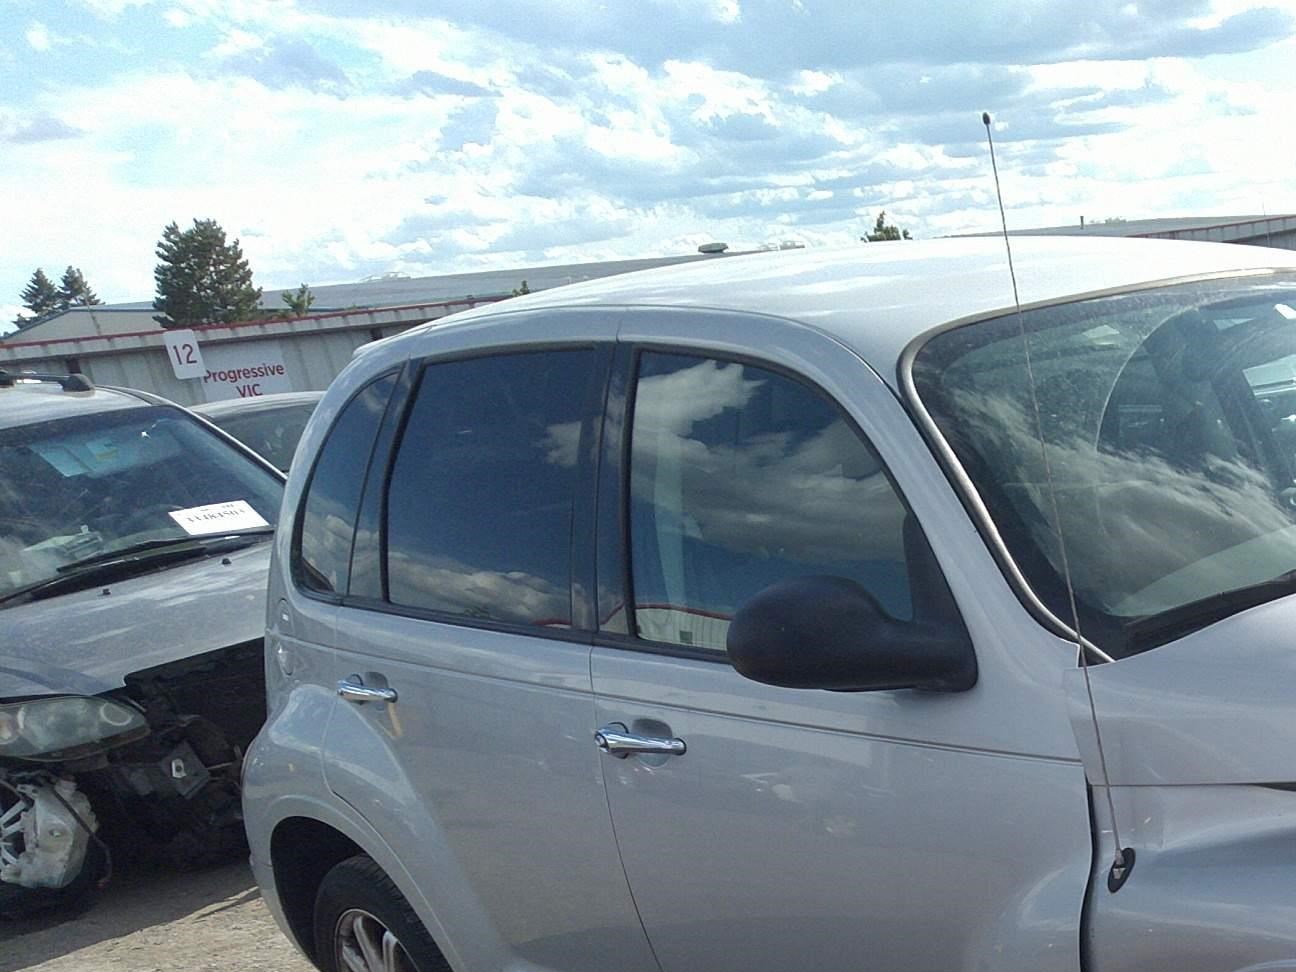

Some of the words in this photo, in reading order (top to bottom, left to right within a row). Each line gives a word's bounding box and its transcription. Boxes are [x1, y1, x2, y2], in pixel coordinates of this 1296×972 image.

[173, 344, 198, 366] 12
[203, 363, 285, 384] Progressive
[236, 383, 264, 398] VIC
